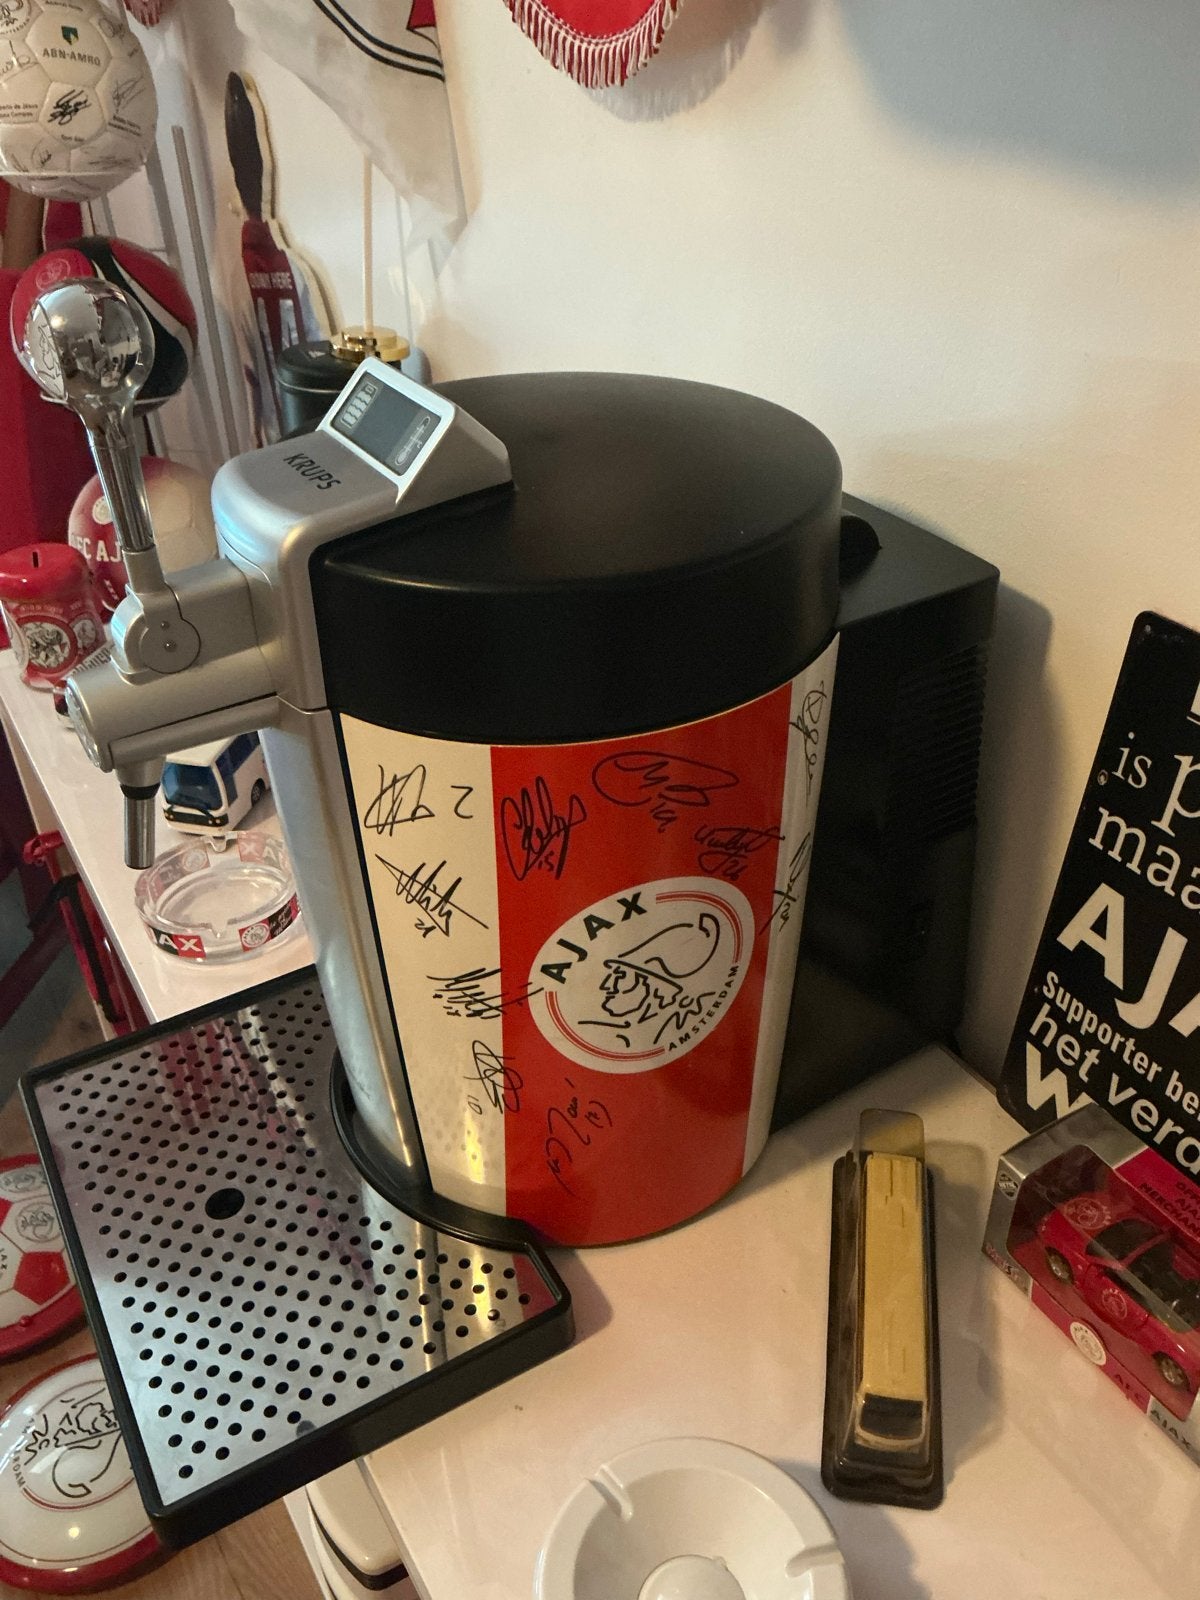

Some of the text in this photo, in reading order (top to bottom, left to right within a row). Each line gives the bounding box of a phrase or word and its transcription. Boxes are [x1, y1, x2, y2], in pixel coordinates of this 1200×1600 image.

[43, 48, 100, 66] ABN-AMRO
[283, 453, 341, 490] KRUPS
[96, 540, 122, 562] AJ
[1112, 731, 1152, 789] is
[541, 892, 647, 984] AJAX
[668, 965, 739, 1051] AMSTERDAM
[1029, 1002, 1100, 1083] het
[1042, 971, 1200, 1121] Supporter be
